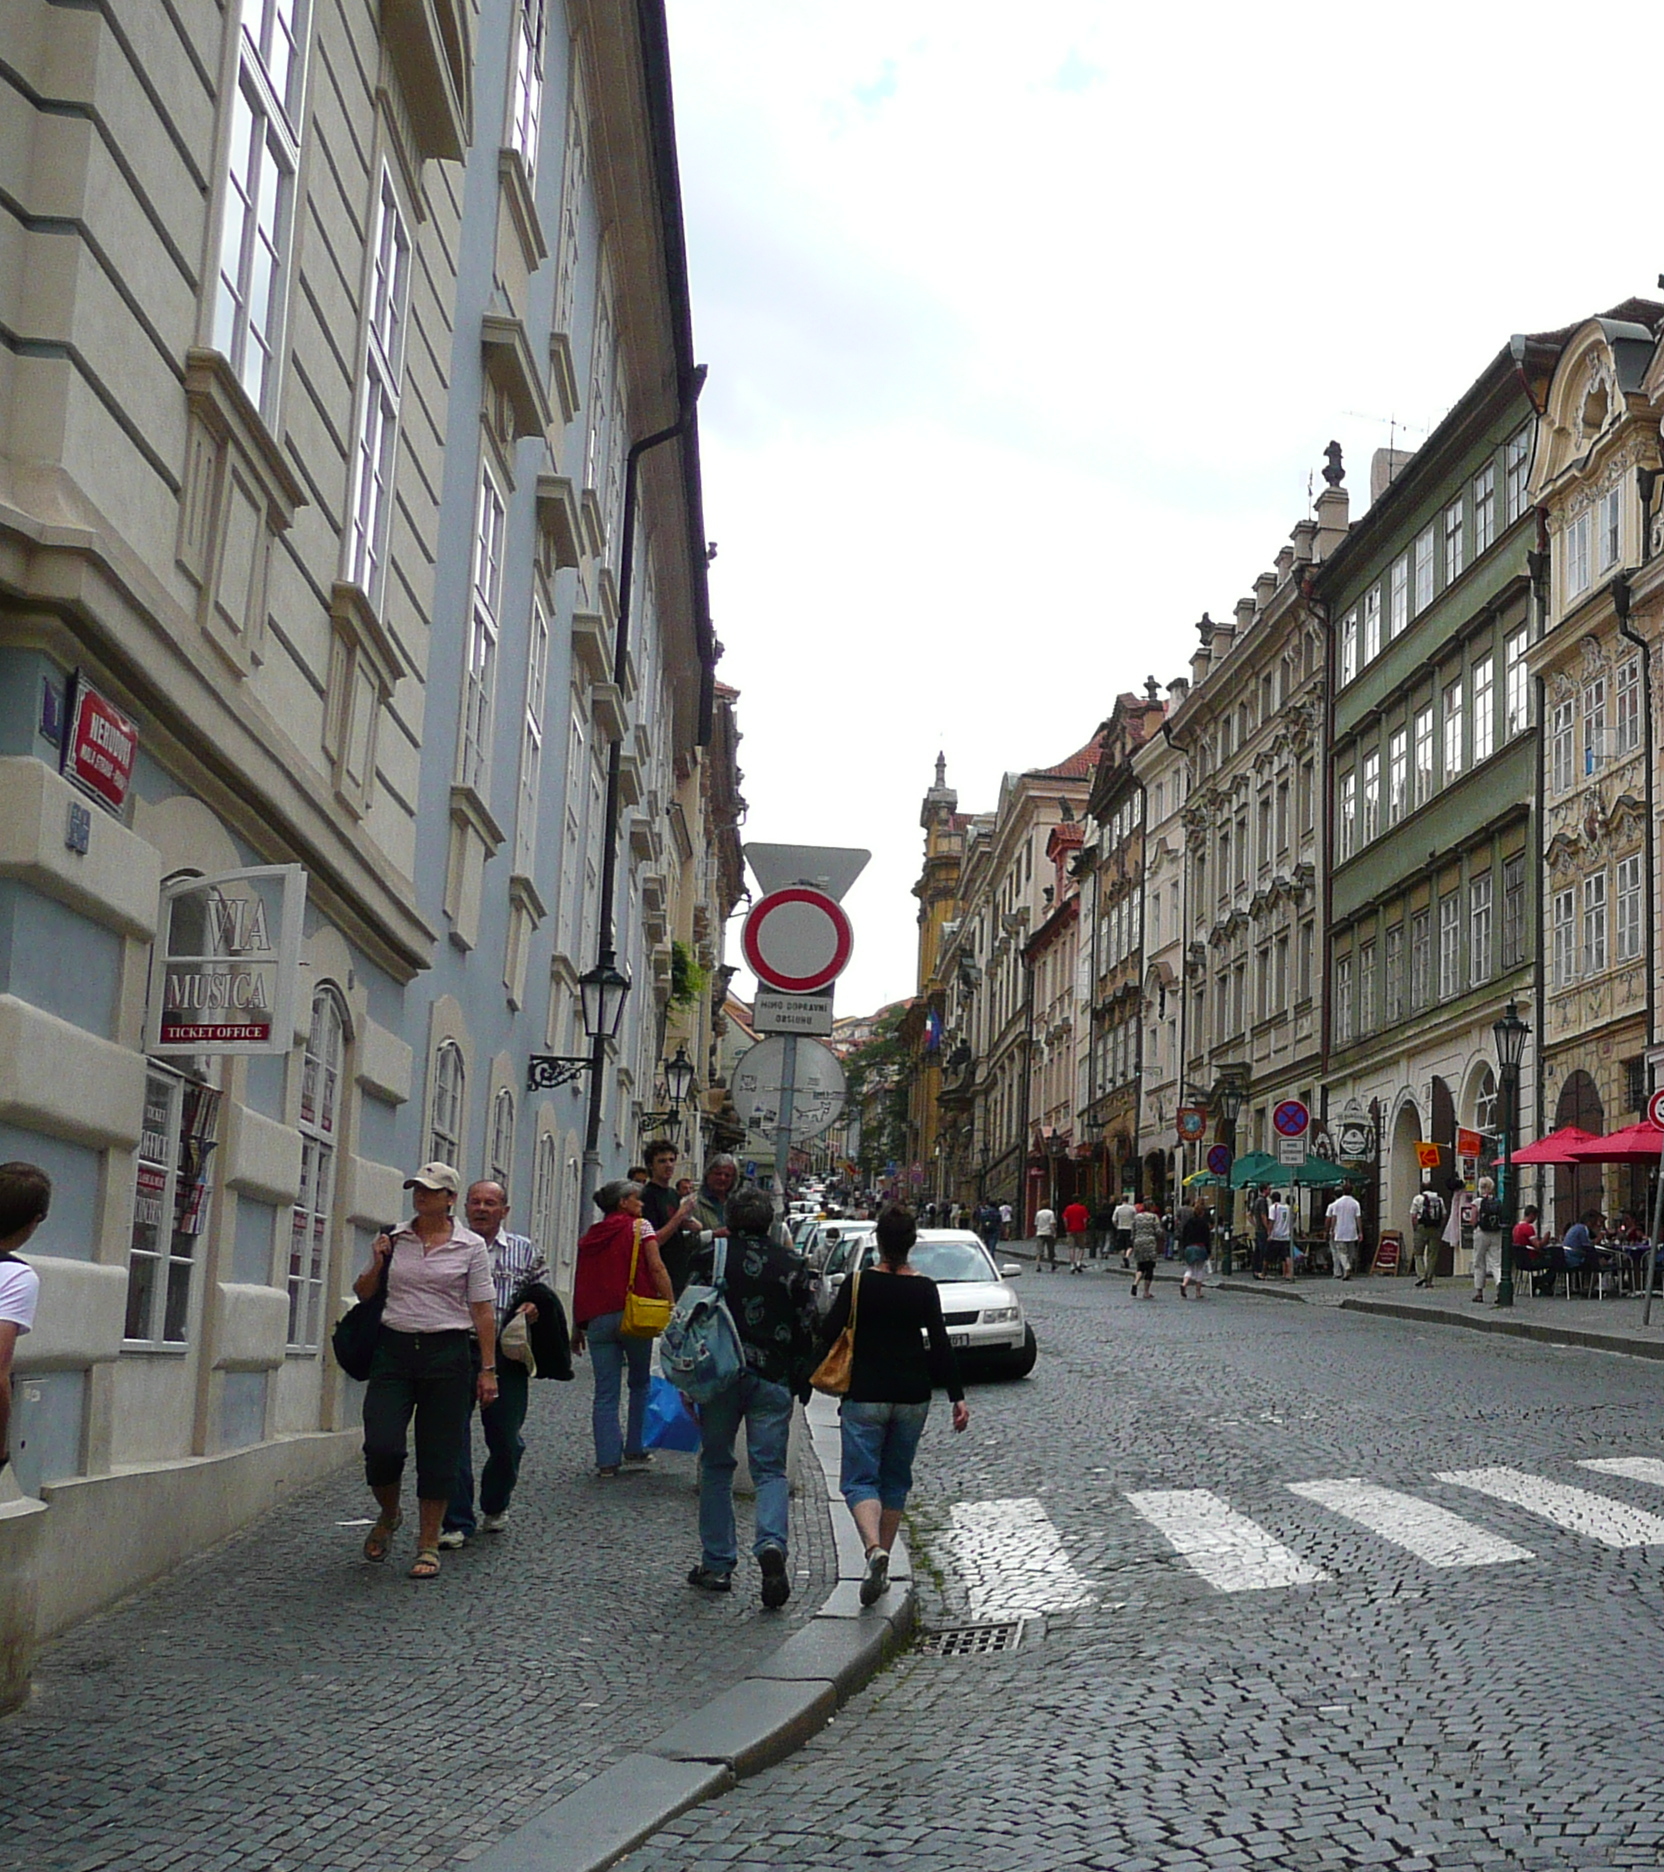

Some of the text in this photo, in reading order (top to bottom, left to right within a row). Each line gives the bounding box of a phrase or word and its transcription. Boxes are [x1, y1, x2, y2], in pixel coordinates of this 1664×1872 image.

[207, 898, 271, 951] VIA
[168, 972, 268, 1009] MUSICA
[167, 1026, 263, 1038] TICKET OFFICE
